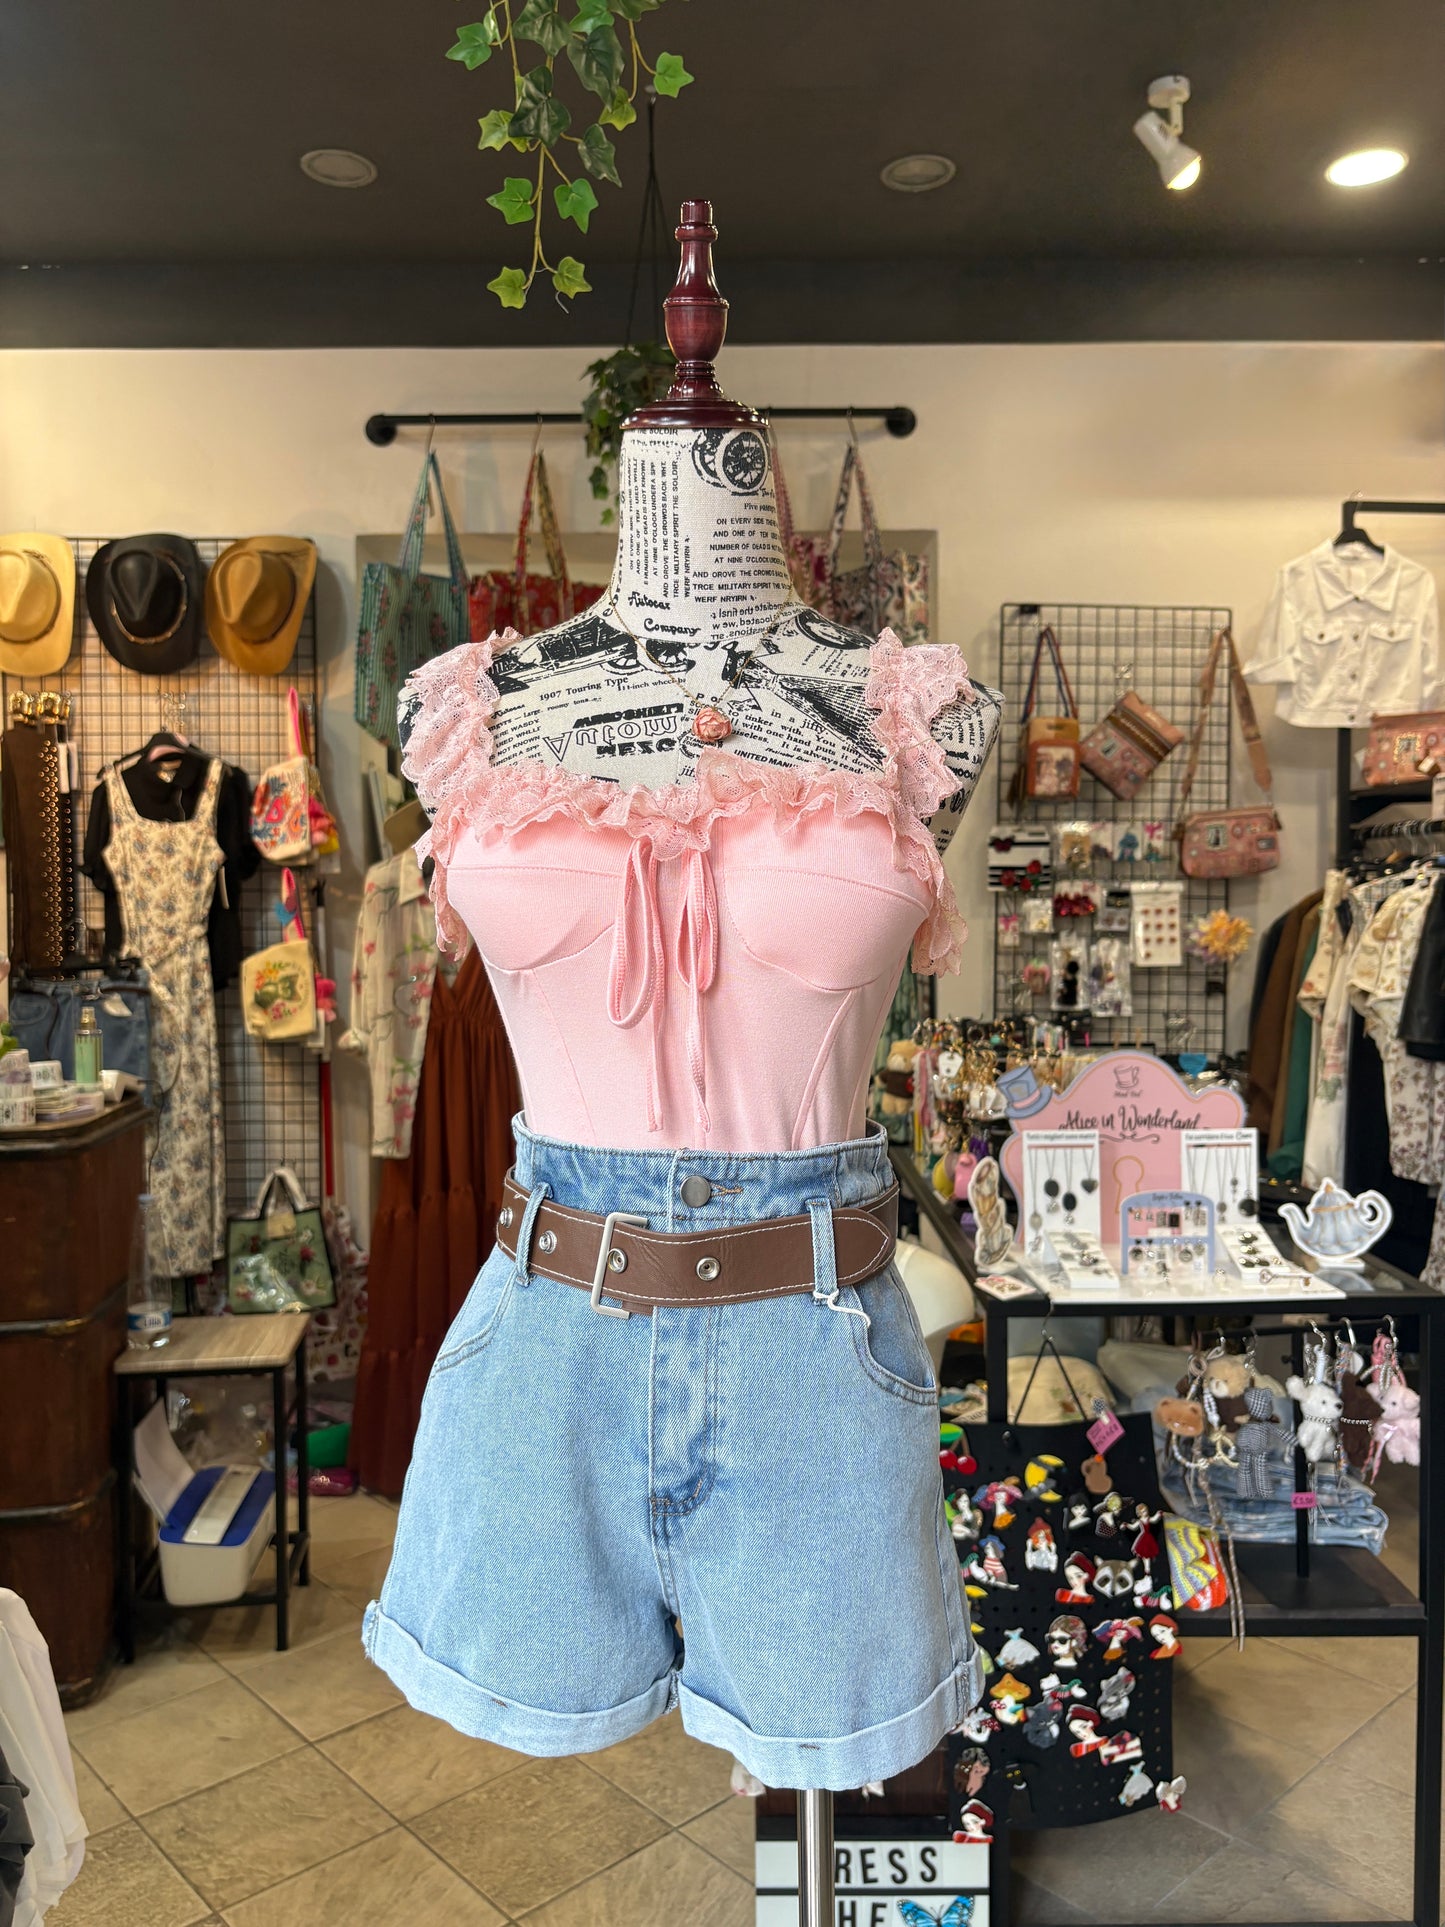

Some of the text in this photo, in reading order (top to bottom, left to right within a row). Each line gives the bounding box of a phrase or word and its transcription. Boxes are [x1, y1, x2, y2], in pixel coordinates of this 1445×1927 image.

[653, 566, 658, 576] AT
[644, 618, 701, 636] Company
[539, 690, 562, 701] 1907
[566, 683, 602, 696] Touring
[604, 676, 629, 691] Type
[745, 714, 773, 726] tinker
[780, 724, 804, 737] with.
[815, 734, 836, 748] You
[770, 709, 782, 718] in
[800, 719, 829, 735] jiffy.
[498, 746, 511, 756] NOT
[512, 736, 540, 748] KNOWN
[734, 749, 768, 763] UNITED
[742, 722, 763, 732] with
[766, 728, 785, 738] one
[786, 734, 811, 747] hand
[815, 744, 836, 756] puts
[852, 757, 876, 772] down
[802, 750, 838, 766] always
[1059, 1105, 1201, 1130] Alice in Wonderland
[835, 1846, 937, 1884] RESS
[838, 1900, 887, 1927] HE
